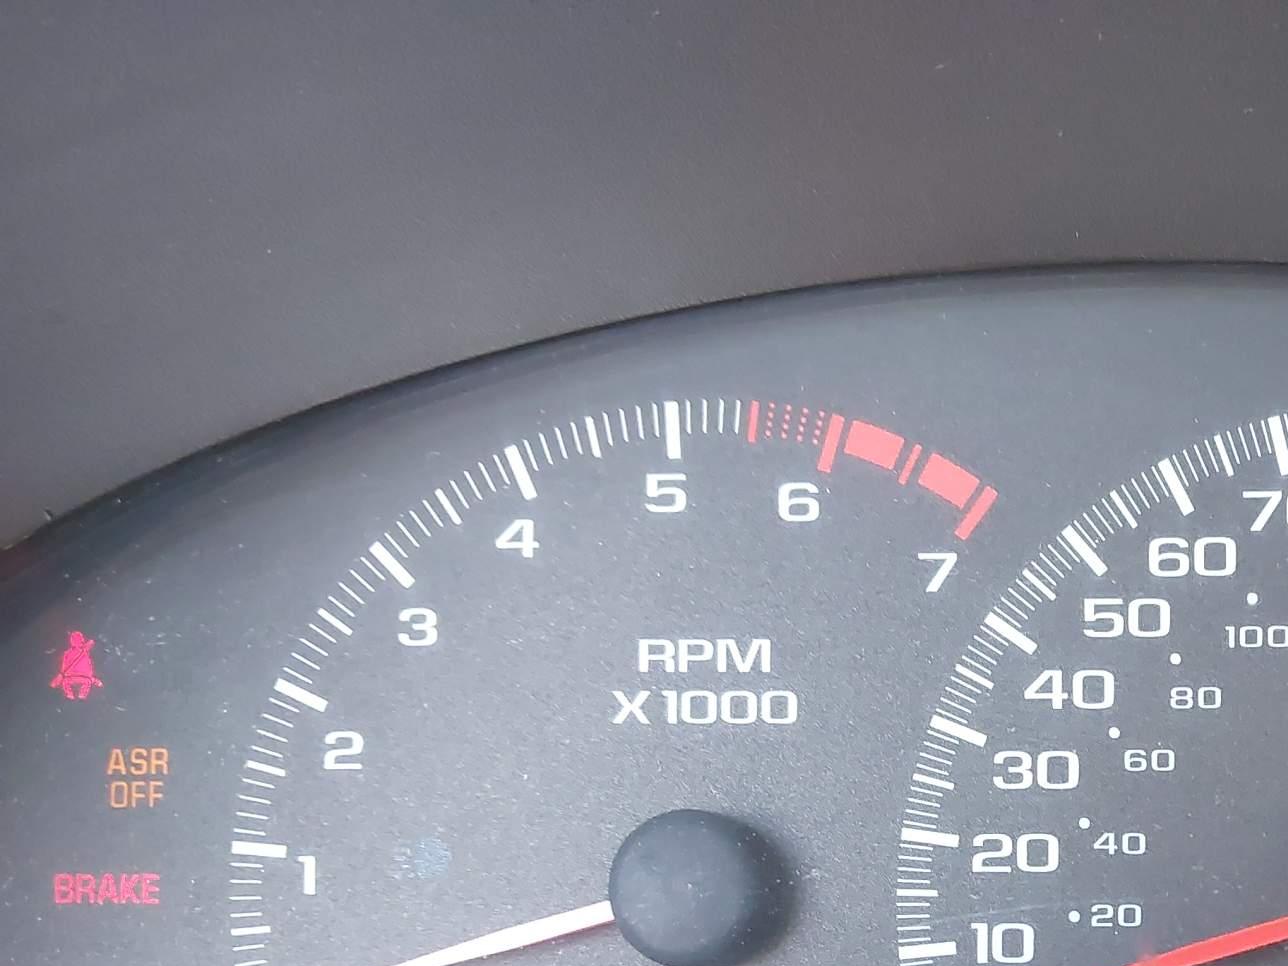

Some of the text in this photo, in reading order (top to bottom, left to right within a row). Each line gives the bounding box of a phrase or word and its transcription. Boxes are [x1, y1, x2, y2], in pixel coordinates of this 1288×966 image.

[644, 473, 689, 514] 5
[776, 482, 822, 522] 6
[495, 518, 540, 560] 4
[1147, 535, 1238, 578] 60
[916, 552, 959, 593] 7
[397, 607, 439, 647] 3
[1082, 597, 1171, 639] 50
[636, 638, 772, 673] RPM
[1023, 668, 1116, 711] 40
[1169, 686, 1223, 710] 80
[107, 748, 169, 776] ASR
[322, 731, 365, 771] 2
[992, 750, 1080, 791] 30
[1123, 748, 1175, 773] 60
[108, 780, 163, 809] OFF
[970, 832, 1060, 874] 20
[1092, 832, 1147, 857] 40
[53, 873, 161, 906] BRAKE
[297, 855, 317, 896] 1
[1090, 904, 1143, 928] 20
[970, 922, 1035, 964] 10
